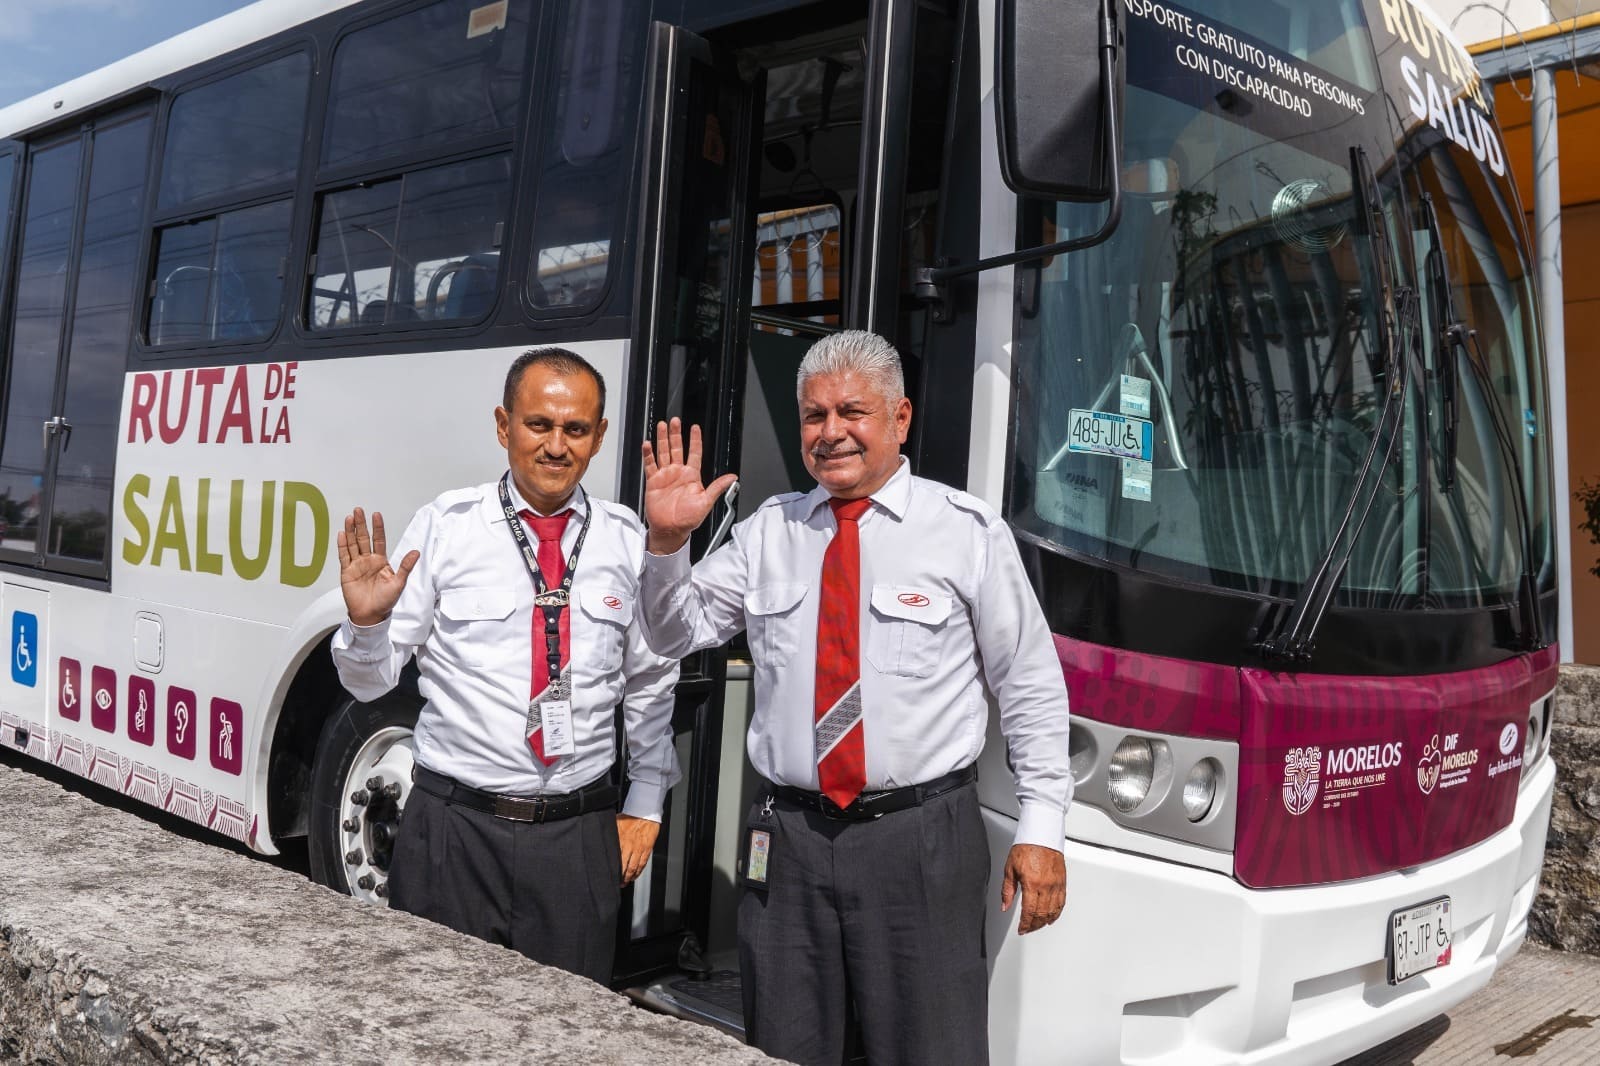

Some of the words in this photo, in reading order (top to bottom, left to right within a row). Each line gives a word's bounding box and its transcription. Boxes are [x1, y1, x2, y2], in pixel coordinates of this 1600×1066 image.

[1176, 44, 1209, 75] CON
[1213, 59, 1311, 117] DISCAPACIDAD
[1197, 23, 1266, 69] GRATUITO
[1268, 55, 1302, 87] PARA
[1303, 71, 1365, 115] PERSONAS
[1379, 0, 1473, 98] RUTA
[1400, 56, 1505, 177] SALUD
[127, 364, 254, 445] RUTA
[264, 361, 298, 400] DE
[260, 406, 291, 444] LA
[122, 473, 330, 588] SALUD
[1326, 742, 1403, 775] MORELOS
[1442, 749, 1479, 771] MORELOS
[1444, 733, 1459, 751] DIF
[1325, 780, 1333, 789] LA
[1333, 778, 1351, 788] TIERRA
[1352, 776, 1364, 786] QUE
[1364, 774, 1375, 784] NOS
[1375, 772, 1386, 782] UNE
